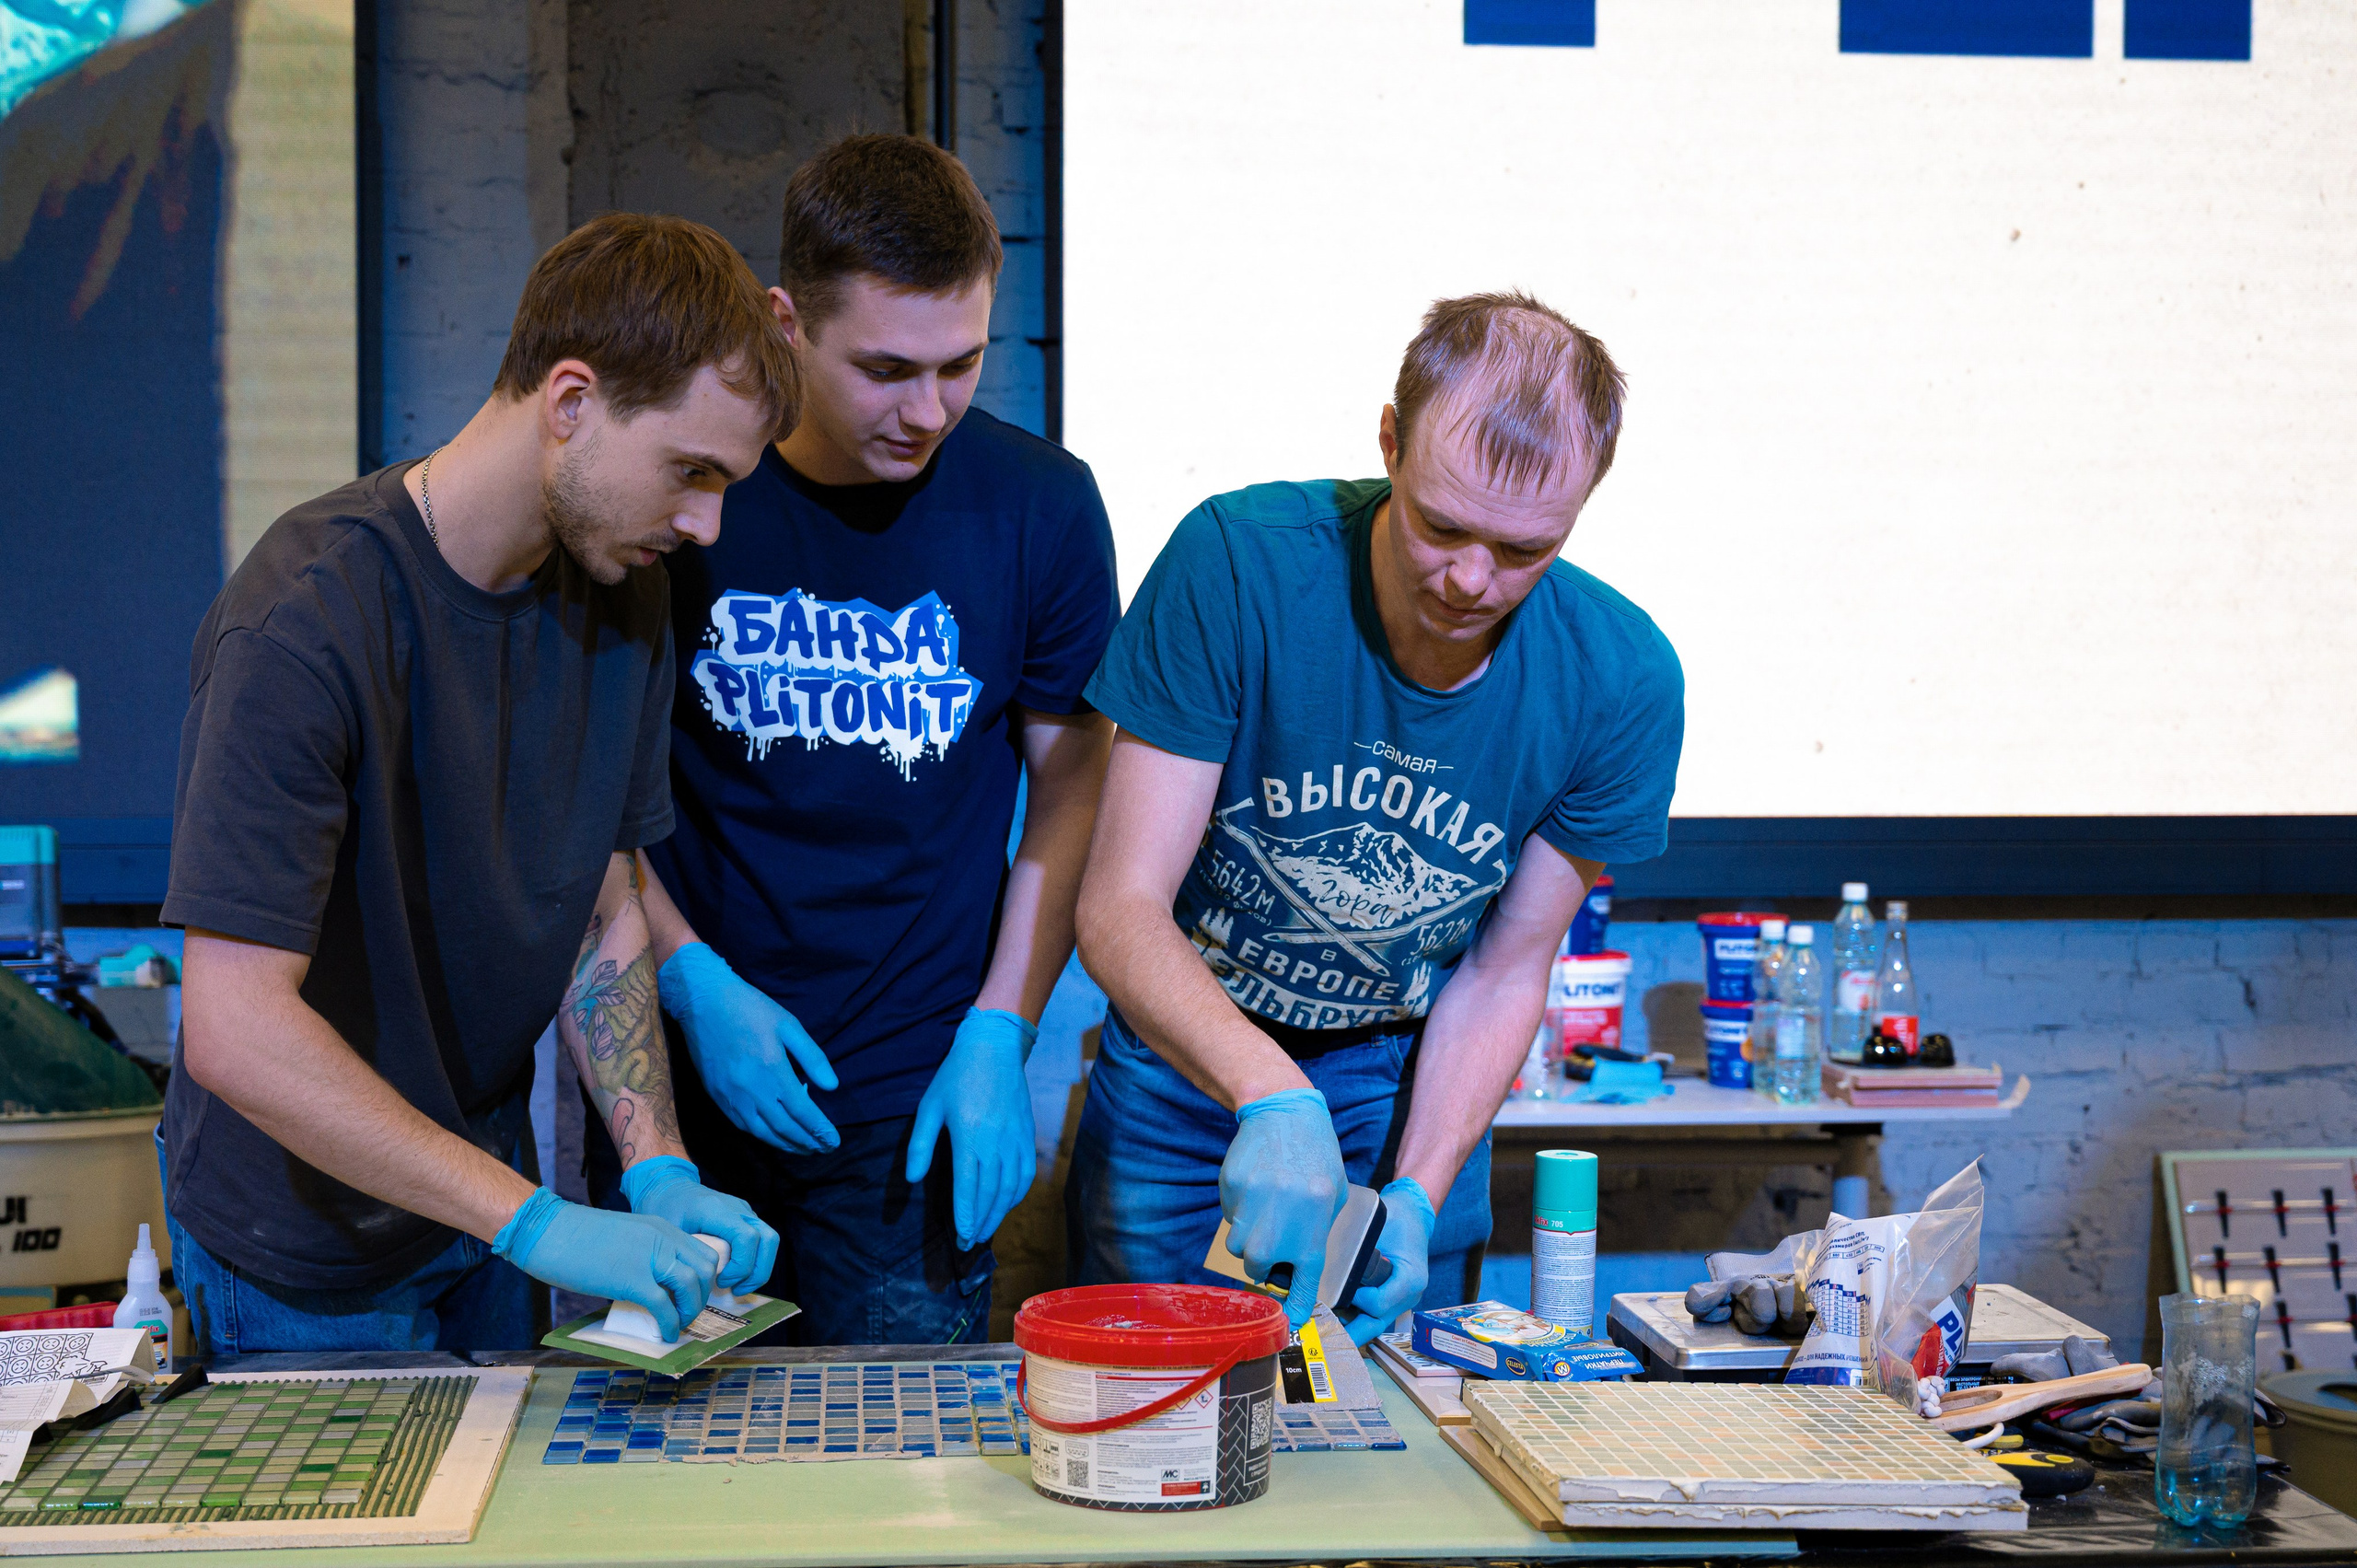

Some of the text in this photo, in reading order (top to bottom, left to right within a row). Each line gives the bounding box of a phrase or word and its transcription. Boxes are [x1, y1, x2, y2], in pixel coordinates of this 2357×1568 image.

[1261, 763, 1505, 865] ВЫСОКАЯ
[1320, 948, 1338, 962] В
[1237, 937, 1400, 1002] ЕВРОПЕ
[1550, 1220, 1564, 1228] 705
[1571, 1351, 1626, 1363] НИТРИЛОВЫЕ
[1814, 1352, 1846, 1361] НАДЕЖНЫХ
[1507, 1359, 1524, 1370] CELESTA
[1584, 1358, 1625, 1370] ПЕРЧАТКИ
